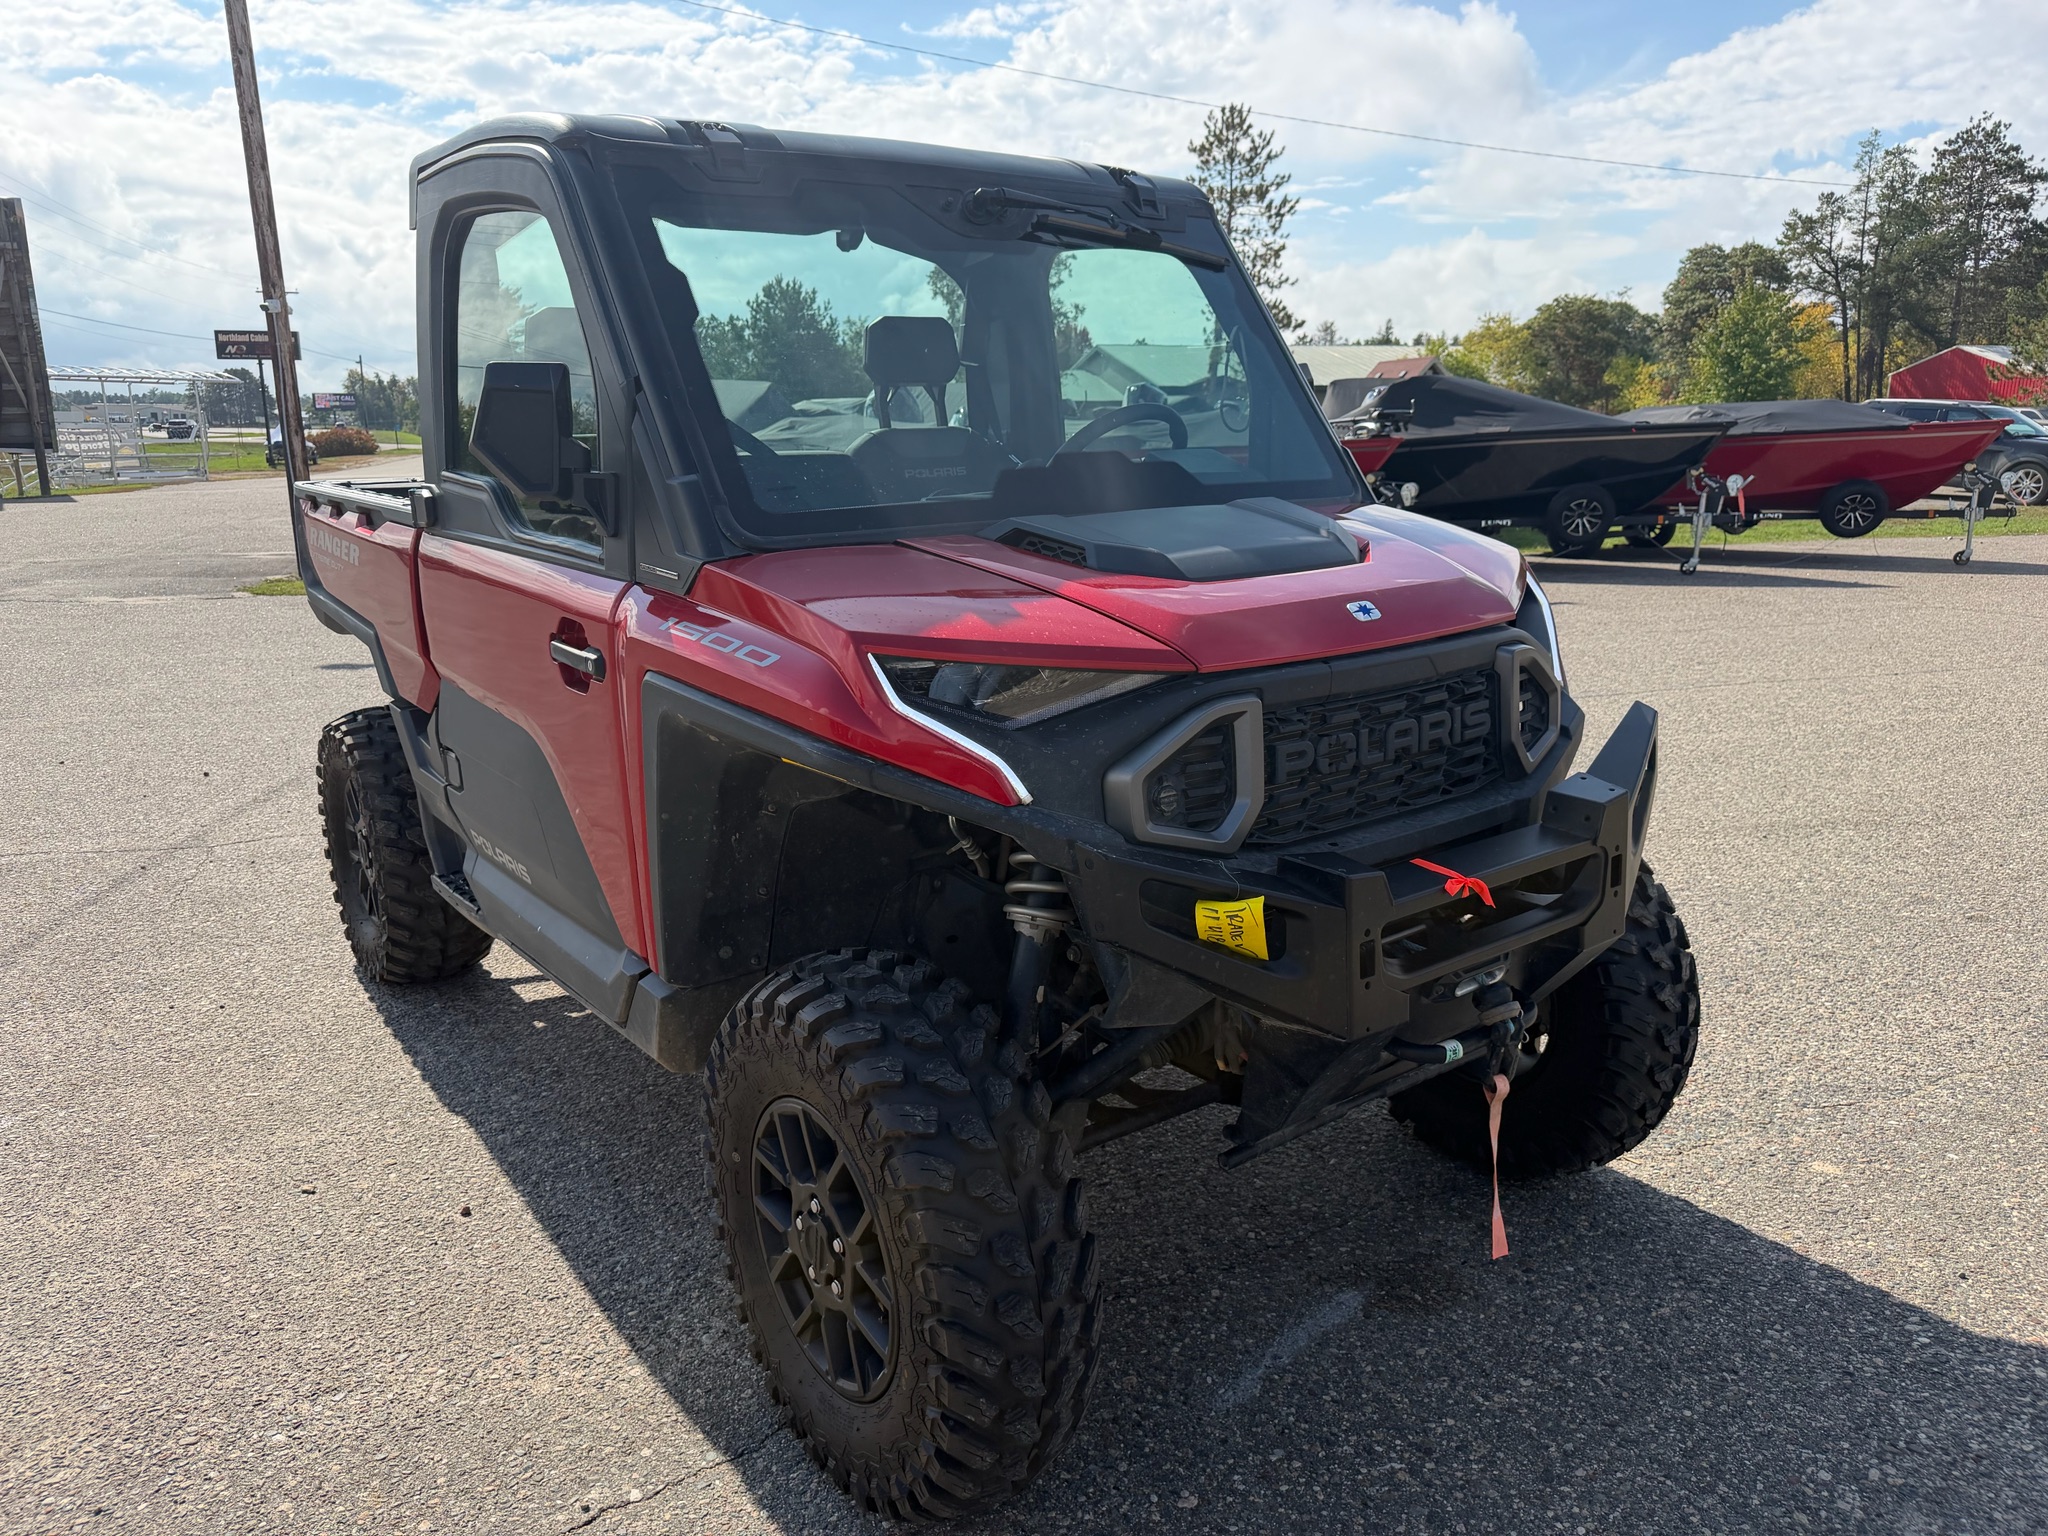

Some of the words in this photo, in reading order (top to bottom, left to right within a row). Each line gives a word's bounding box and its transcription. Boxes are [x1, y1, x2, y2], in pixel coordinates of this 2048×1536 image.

[218, 333, 249, 342] Northland
[904, 466, 967, 478] POLARIS
[310, 526, 360, 566] RANGER
[659, 617, 781, 668] 1500
[1274, 700, 1491, 785] POLARIS
[470, 829, 532, 885] POLARIS
